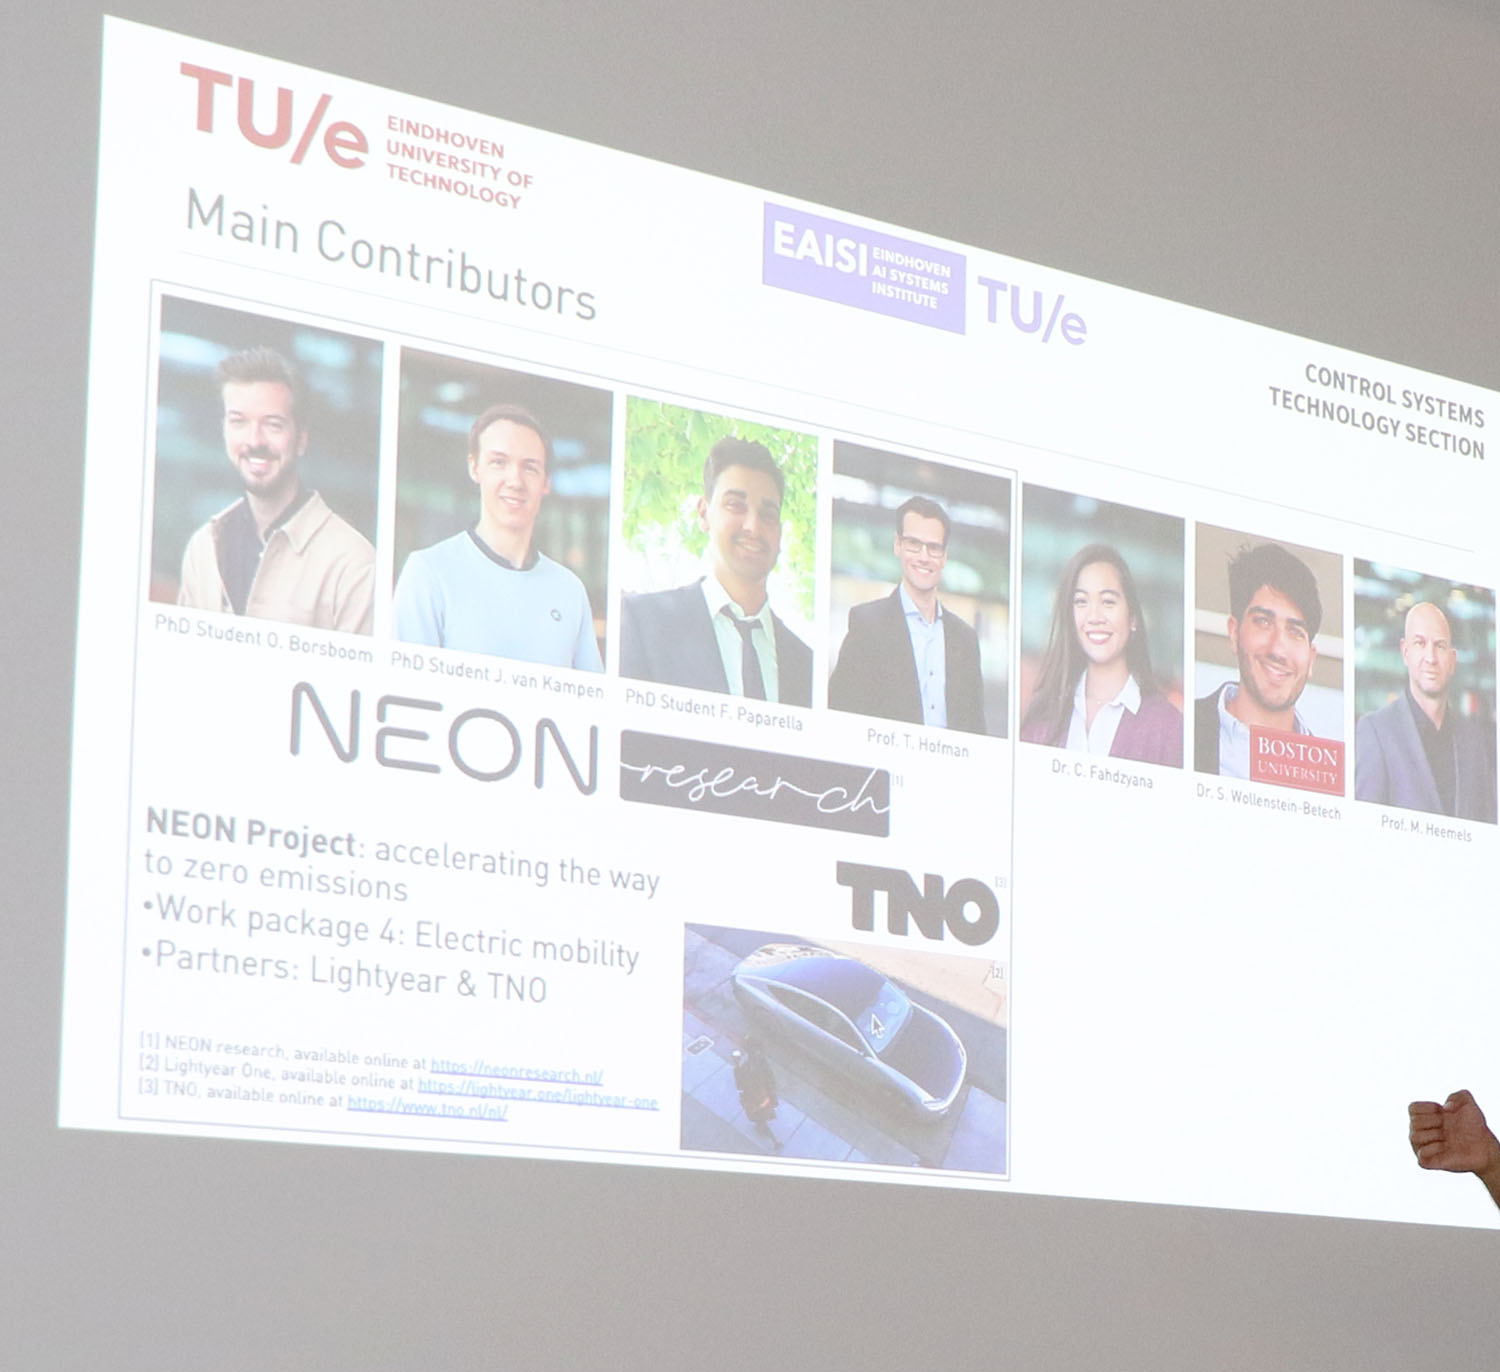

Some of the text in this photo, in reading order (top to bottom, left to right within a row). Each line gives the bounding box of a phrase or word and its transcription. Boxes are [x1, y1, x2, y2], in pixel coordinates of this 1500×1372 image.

[180, 62, 369, 170] TU/e
[387, 115, 505, 159] EINDHOVEN
[386, 139, 533, 189] UNIVERSITY OF
[387, 163, 521, 209] TECHNOLOGY
[187, 187, 597, 321] Main Contributors
[773, 220, 868, 277] EAISI
[872, 246, 951, 278] EINDHOVEN
[872, 265, 949, 295] AI SYSTEMS
[872, 281, 938, 309] INSTITUTE
[977, 275, 1087, 346] TU/e
[1305, 363, 1485, 429] CONTROL SYSTEMS
[1269, 386, 1485, 460] TECHNOLOGY SECTION
[155, 613, 373, 663] PhD Student O. Borsboom
[391, 651, 604, 699] PhD Student J. van Kampen
[626, 688, 803, 732] PhD Student F. Paparella
[290, 681, 598, 796] NEON
[620, 762, 891, 814] research
[867, 728, 969, 758] Prof. T. Hofman
[1258, 736, 1338, 767] BOSTON
[1052, 759, 1153, 789] Dr. C. Fahdzyana
[1258, 760, 1338, 786] UNIVERSITY
[1197, 783, 1341, 820] Dr. S. Wollenstein-Betech
[1381, 815, 1472, 843] Prof. M. Heemels
[145, 849, 408, 903] to zero emissions
[146, 806, 660, 900] NEON Project: accelerating the way
[836, 860, 1000, 946] TNO
[156, 892, 641, 977] Work package 4: Electric mobility
[156, 939, 547, 1004] Partners: Lightyear & TNO
[139, 1052, 159, 1072] [2]
[165, 1056, 236, 1078] Lightyear
[241, 1062, 276, 1081] One,
[281, 1067, 346, 1085] available
[352, 1073, 395, 1089] online
[400, 1078, 413, 1090] at
[140, 1031, 160, 1050] [1]
[165, 1034, 212, 1052] NEON
[216, 1043, 289, 1060] research,
[294, 1048, 359, 1064] available
[364, 1053, 408, 1068] online
[412, 1058, 426, 1070] at
[138, 1077, 158, 1096] [3]
[164, 1079, 201, 1098] TNO,
[207, 1086, 274, 1103] available
[279, 1092, 324, 1107] online
[329, 1094, 343, 1107] at
